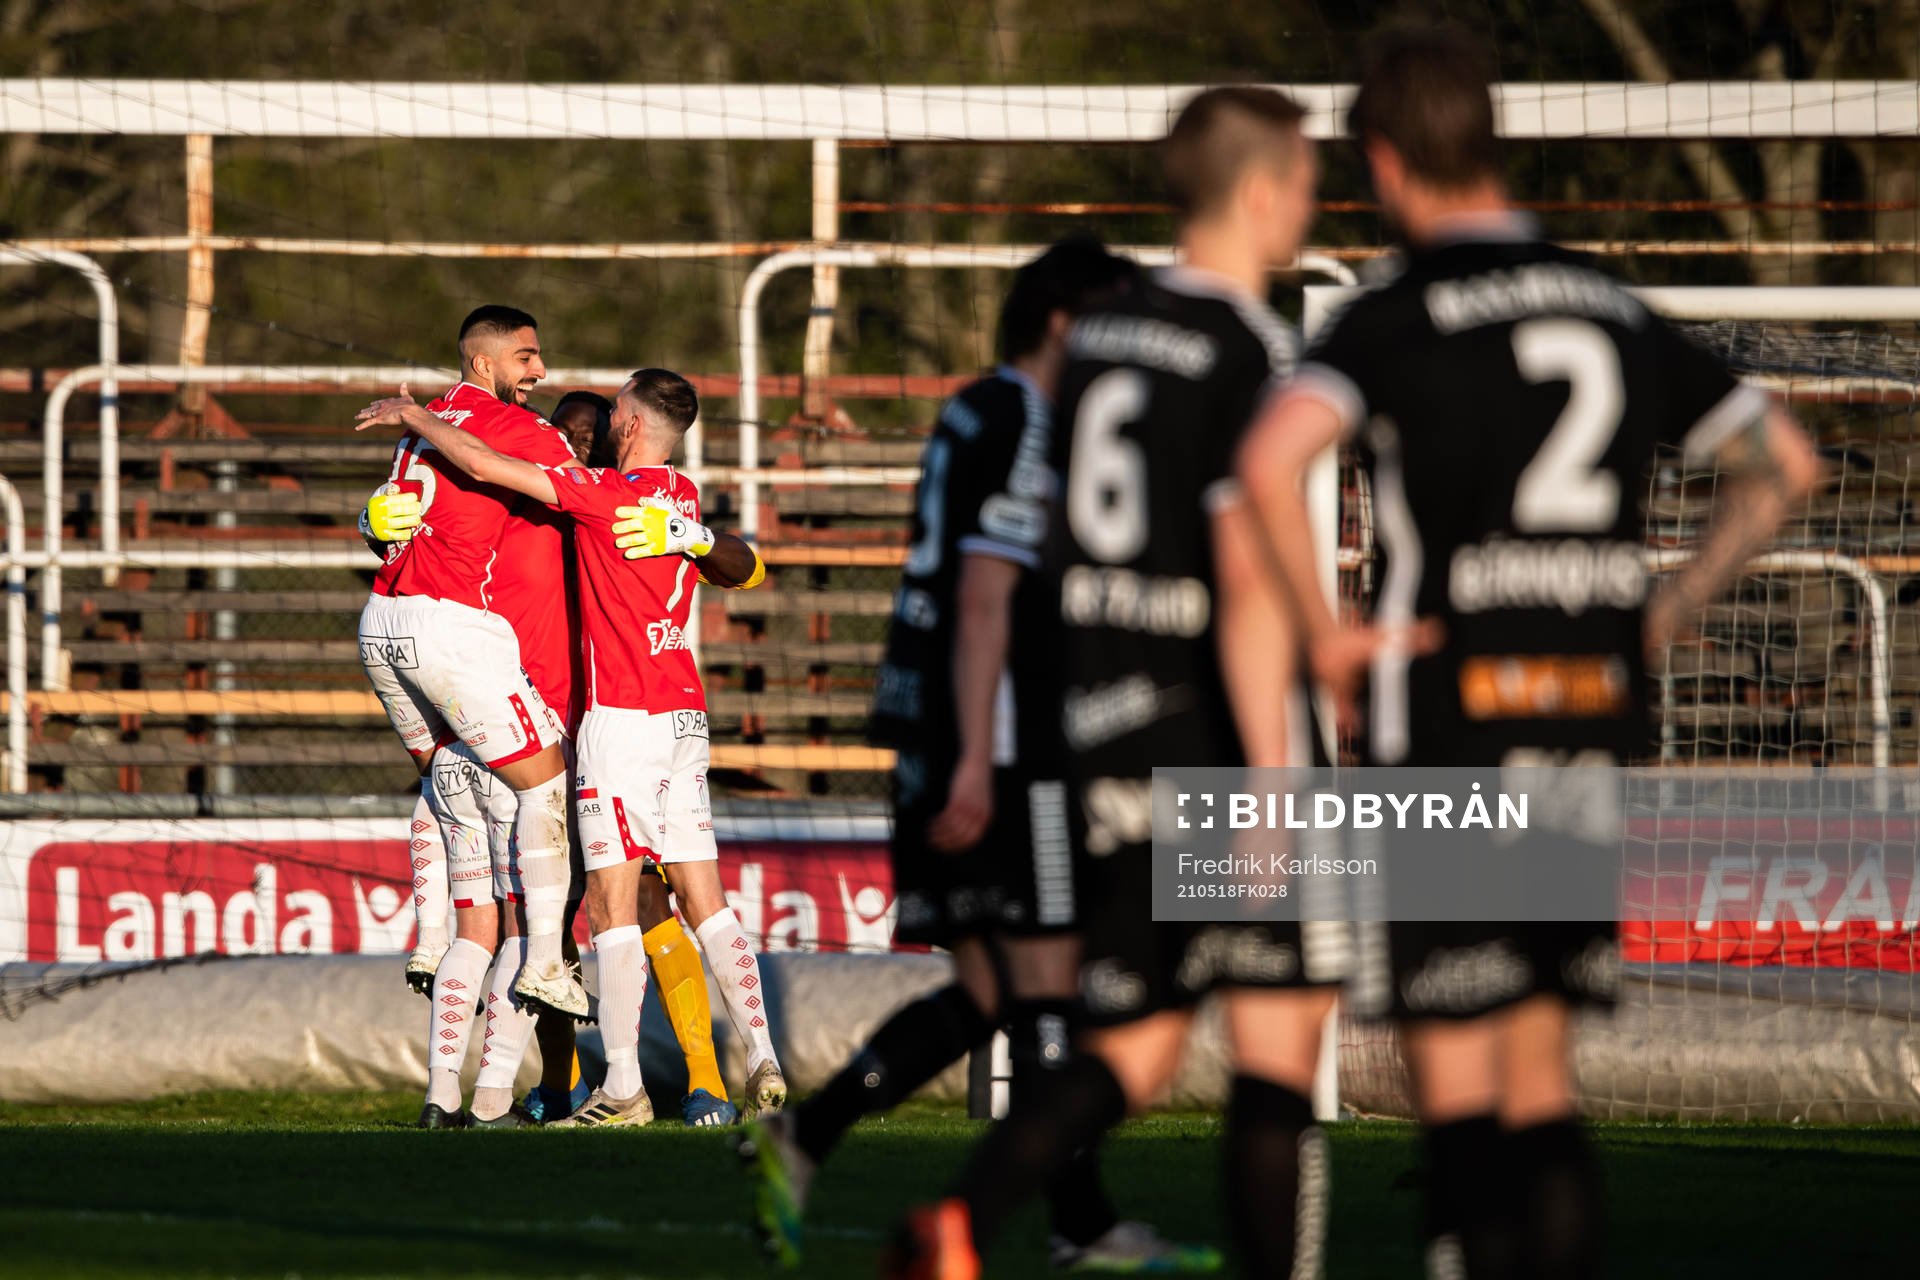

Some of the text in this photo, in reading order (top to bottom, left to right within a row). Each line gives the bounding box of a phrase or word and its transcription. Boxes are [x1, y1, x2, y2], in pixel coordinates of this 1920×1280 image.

[1067, 367, 1149, 565] 6
[1511, 316, 1626, 534] 2
[508, 722, 522, 743] umbro
[56, 863, 333, 963] Landa
